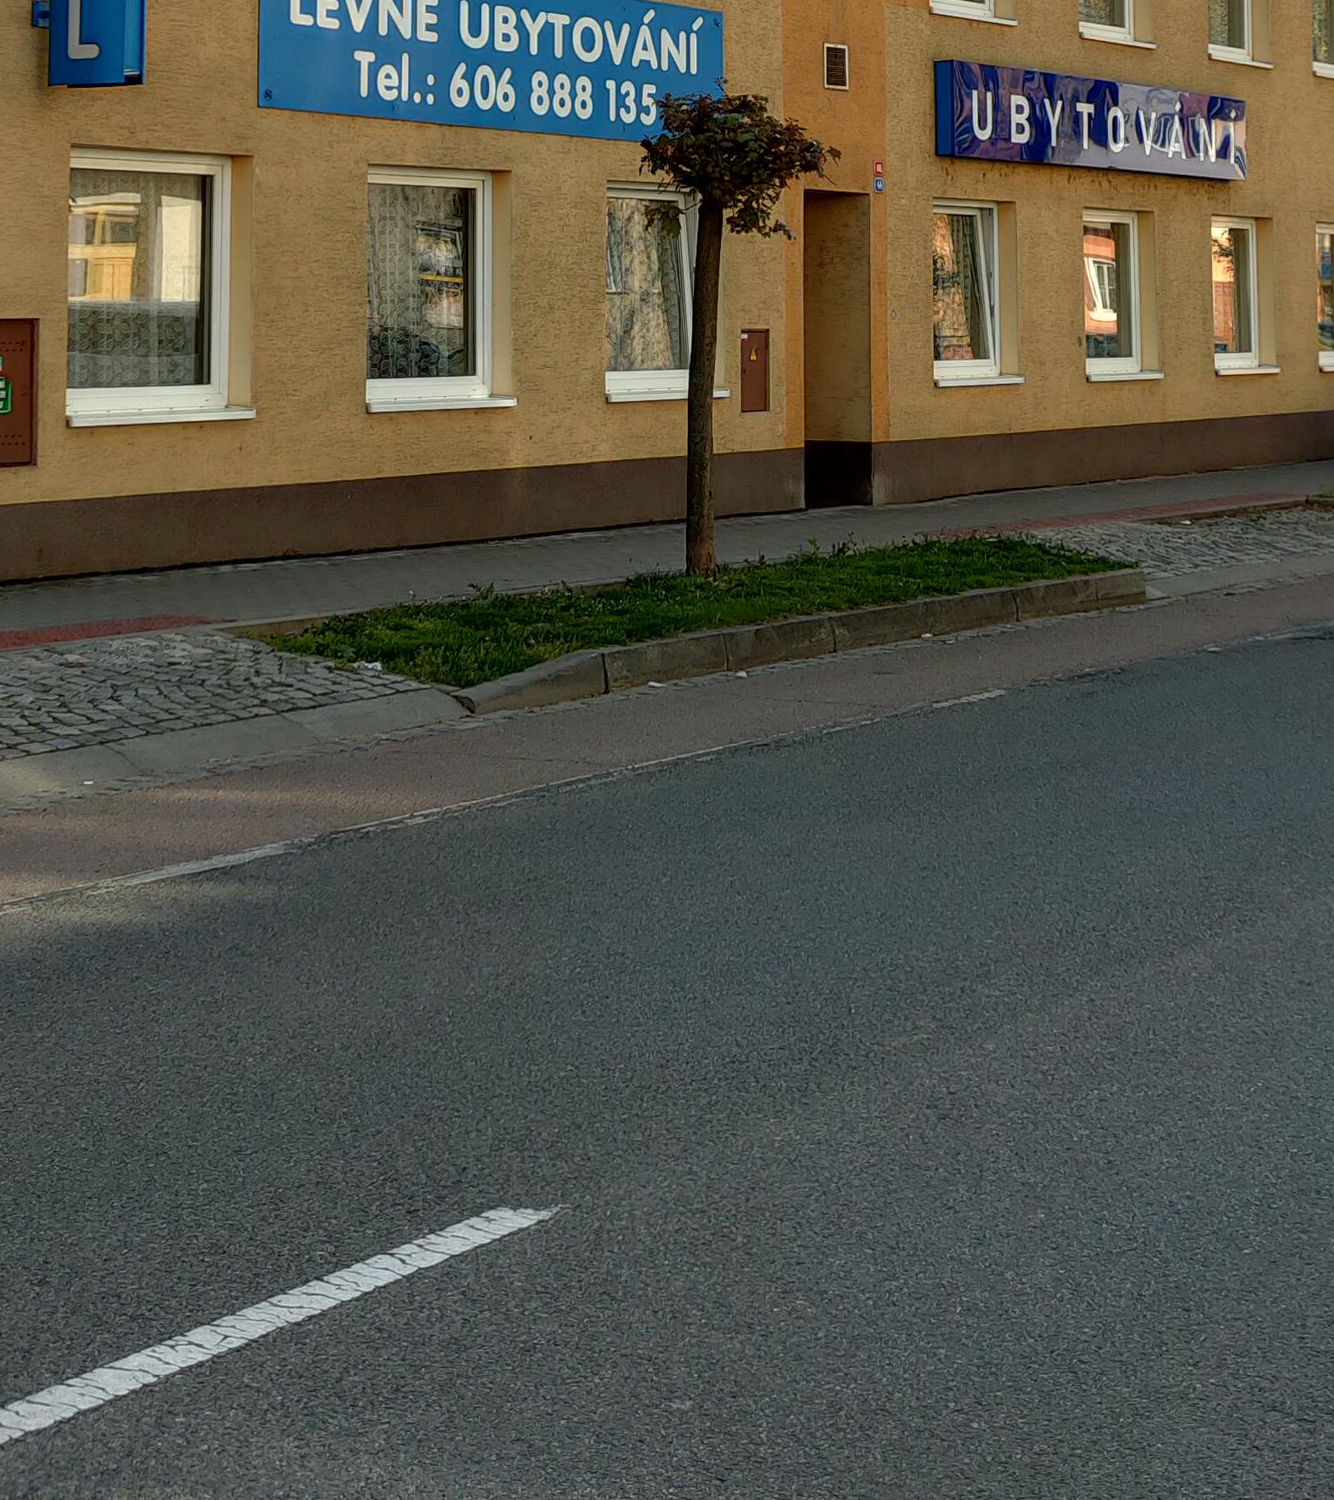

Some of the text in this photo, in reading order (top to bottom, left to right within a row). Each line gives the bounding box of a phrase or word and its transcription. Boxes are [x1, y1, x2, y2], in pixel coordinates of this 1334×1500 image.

[459, 0, 704, 76] UBYTOVÁNÍ
[353, 50, 657, 126] Tel.: 606 888 135
[971, 89, 1238, 165] UBYTOVÁNÍ
